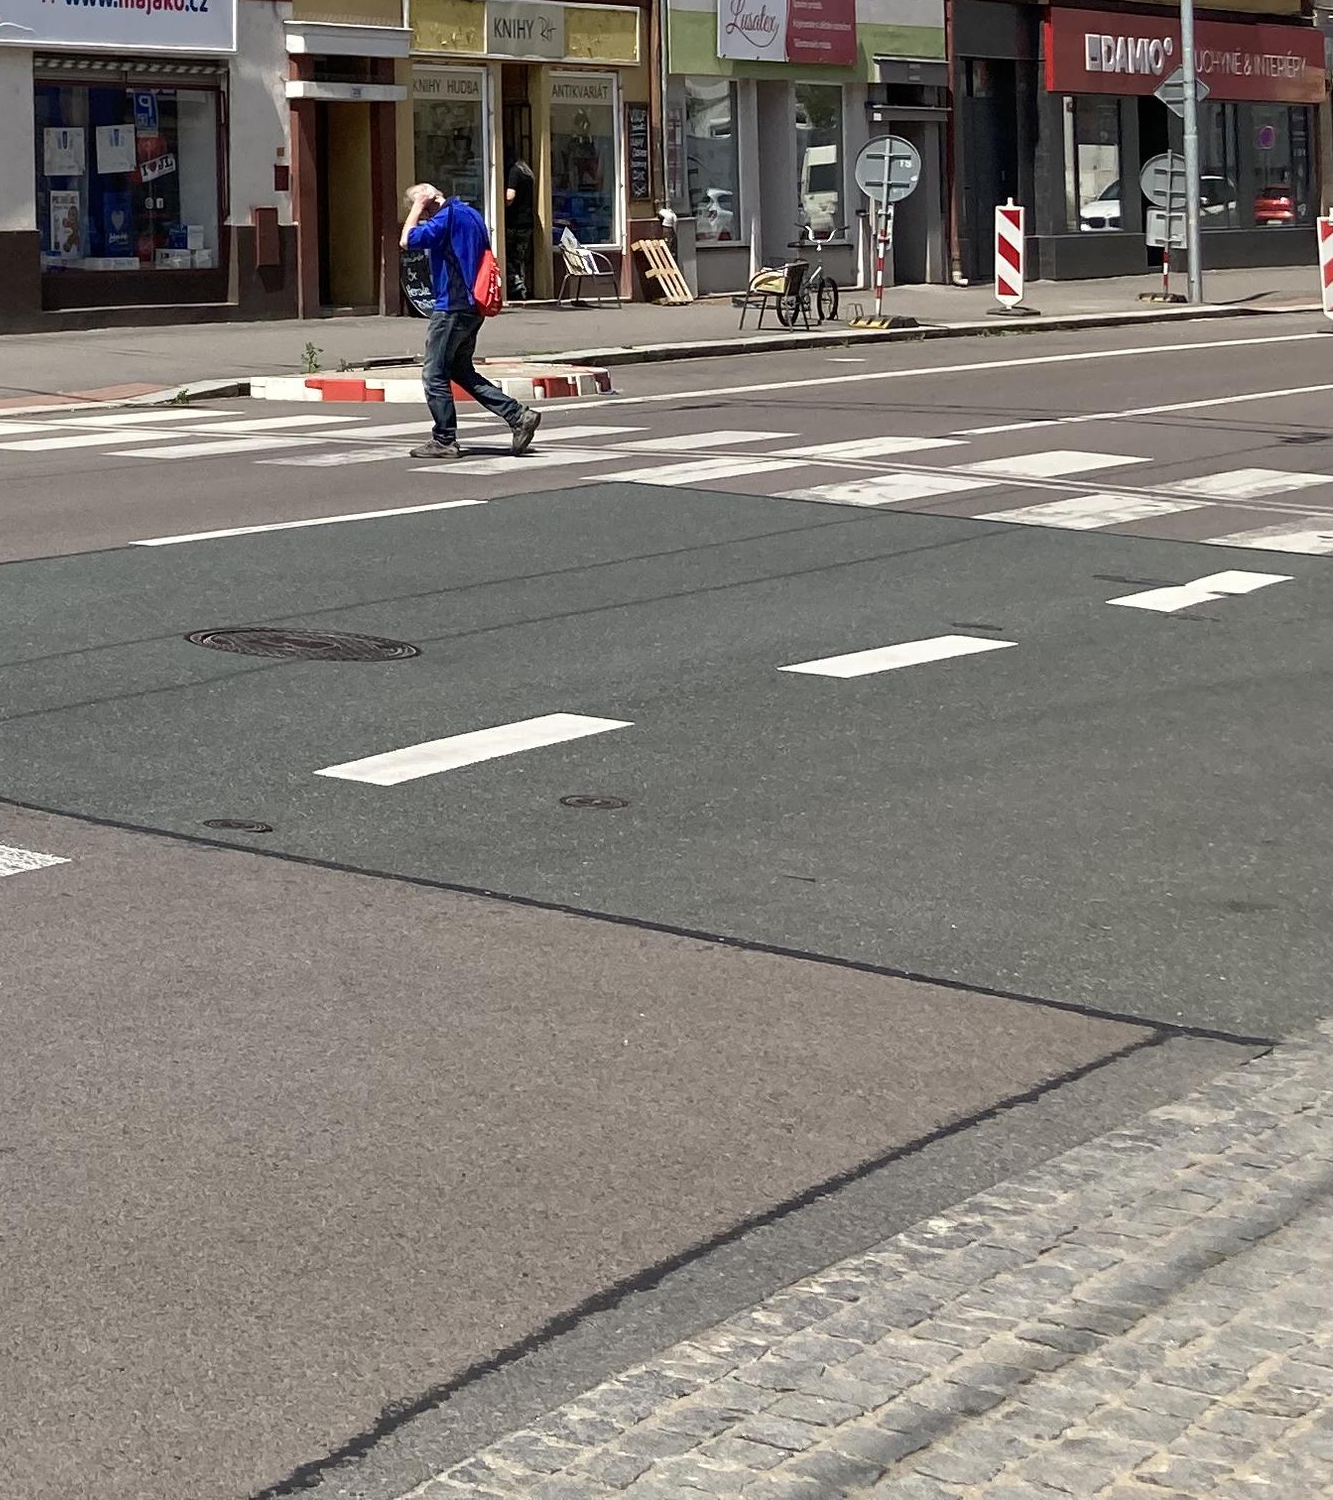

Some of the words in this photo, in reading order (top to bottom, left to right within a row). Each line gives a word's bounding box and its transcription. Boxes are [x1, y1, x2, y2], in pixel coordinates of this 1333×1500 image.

[493, 17, 534, 39] KNIHY
[1194, 48, 1242, 76] UCHYNĚ
[1244, 53, 1252, 75] &
[447, 79, 479, 94] HUDBA
[552, 83, 608, 100] ANTIKVARIÁT
